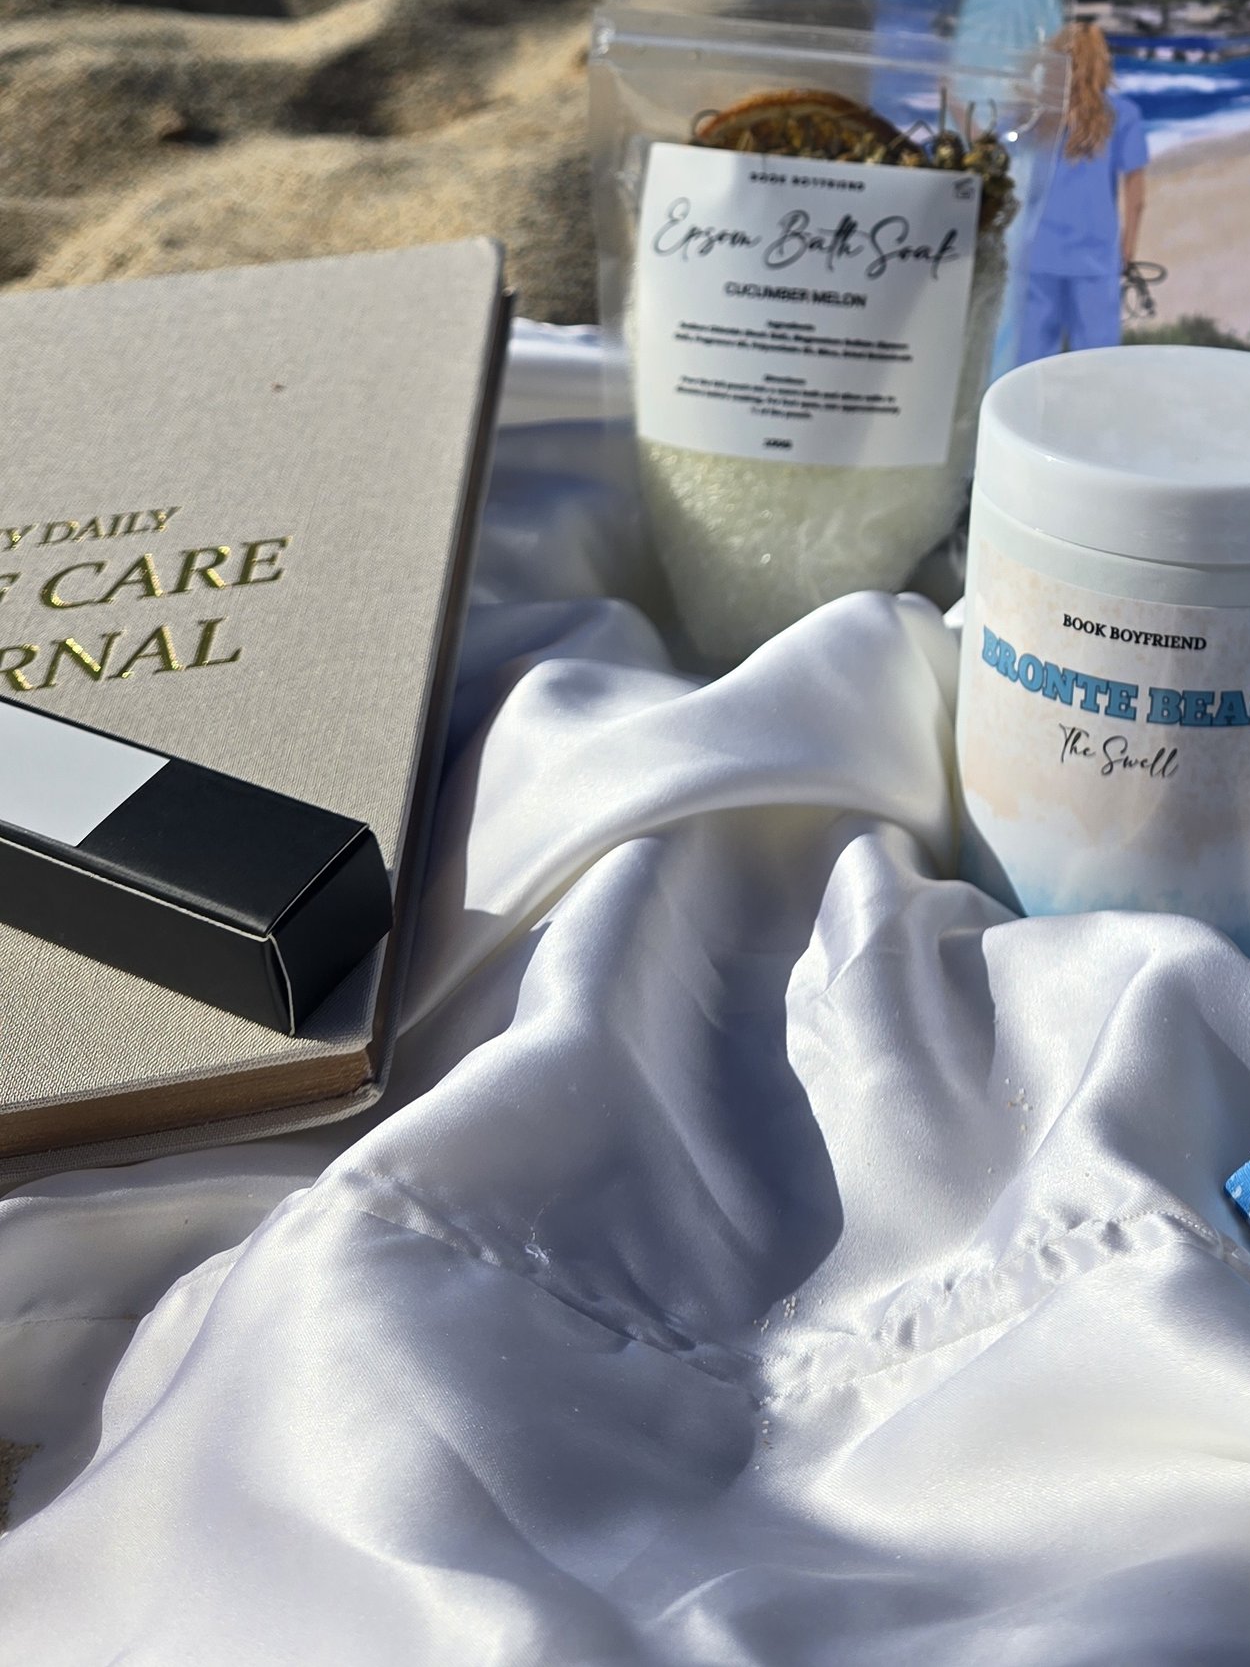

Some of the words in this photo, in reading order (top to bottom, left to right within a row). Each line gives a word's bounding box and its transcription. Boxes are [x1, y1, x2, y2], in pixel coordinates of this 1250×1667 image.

[653, 196, 762, 262] Epsom
[763, 208, 864, 274] Bath
[865, 215, 960, 280] Soak
[724, 281, 810, 304] CUCUMBER
[812, 287, 868, 309] MELON
[37, 505, 183, 545] DAILY
[39, 535, 294, 610] CARE
[1062, 613, 1107, 638] BOOK
[1109, 626, 1208, 651] BOYFRIEND
[982, 624, 1139, 721] BRONTE
[1058, 722, 1096, 764] The
[1100, 734, 1180, 778] Swell
